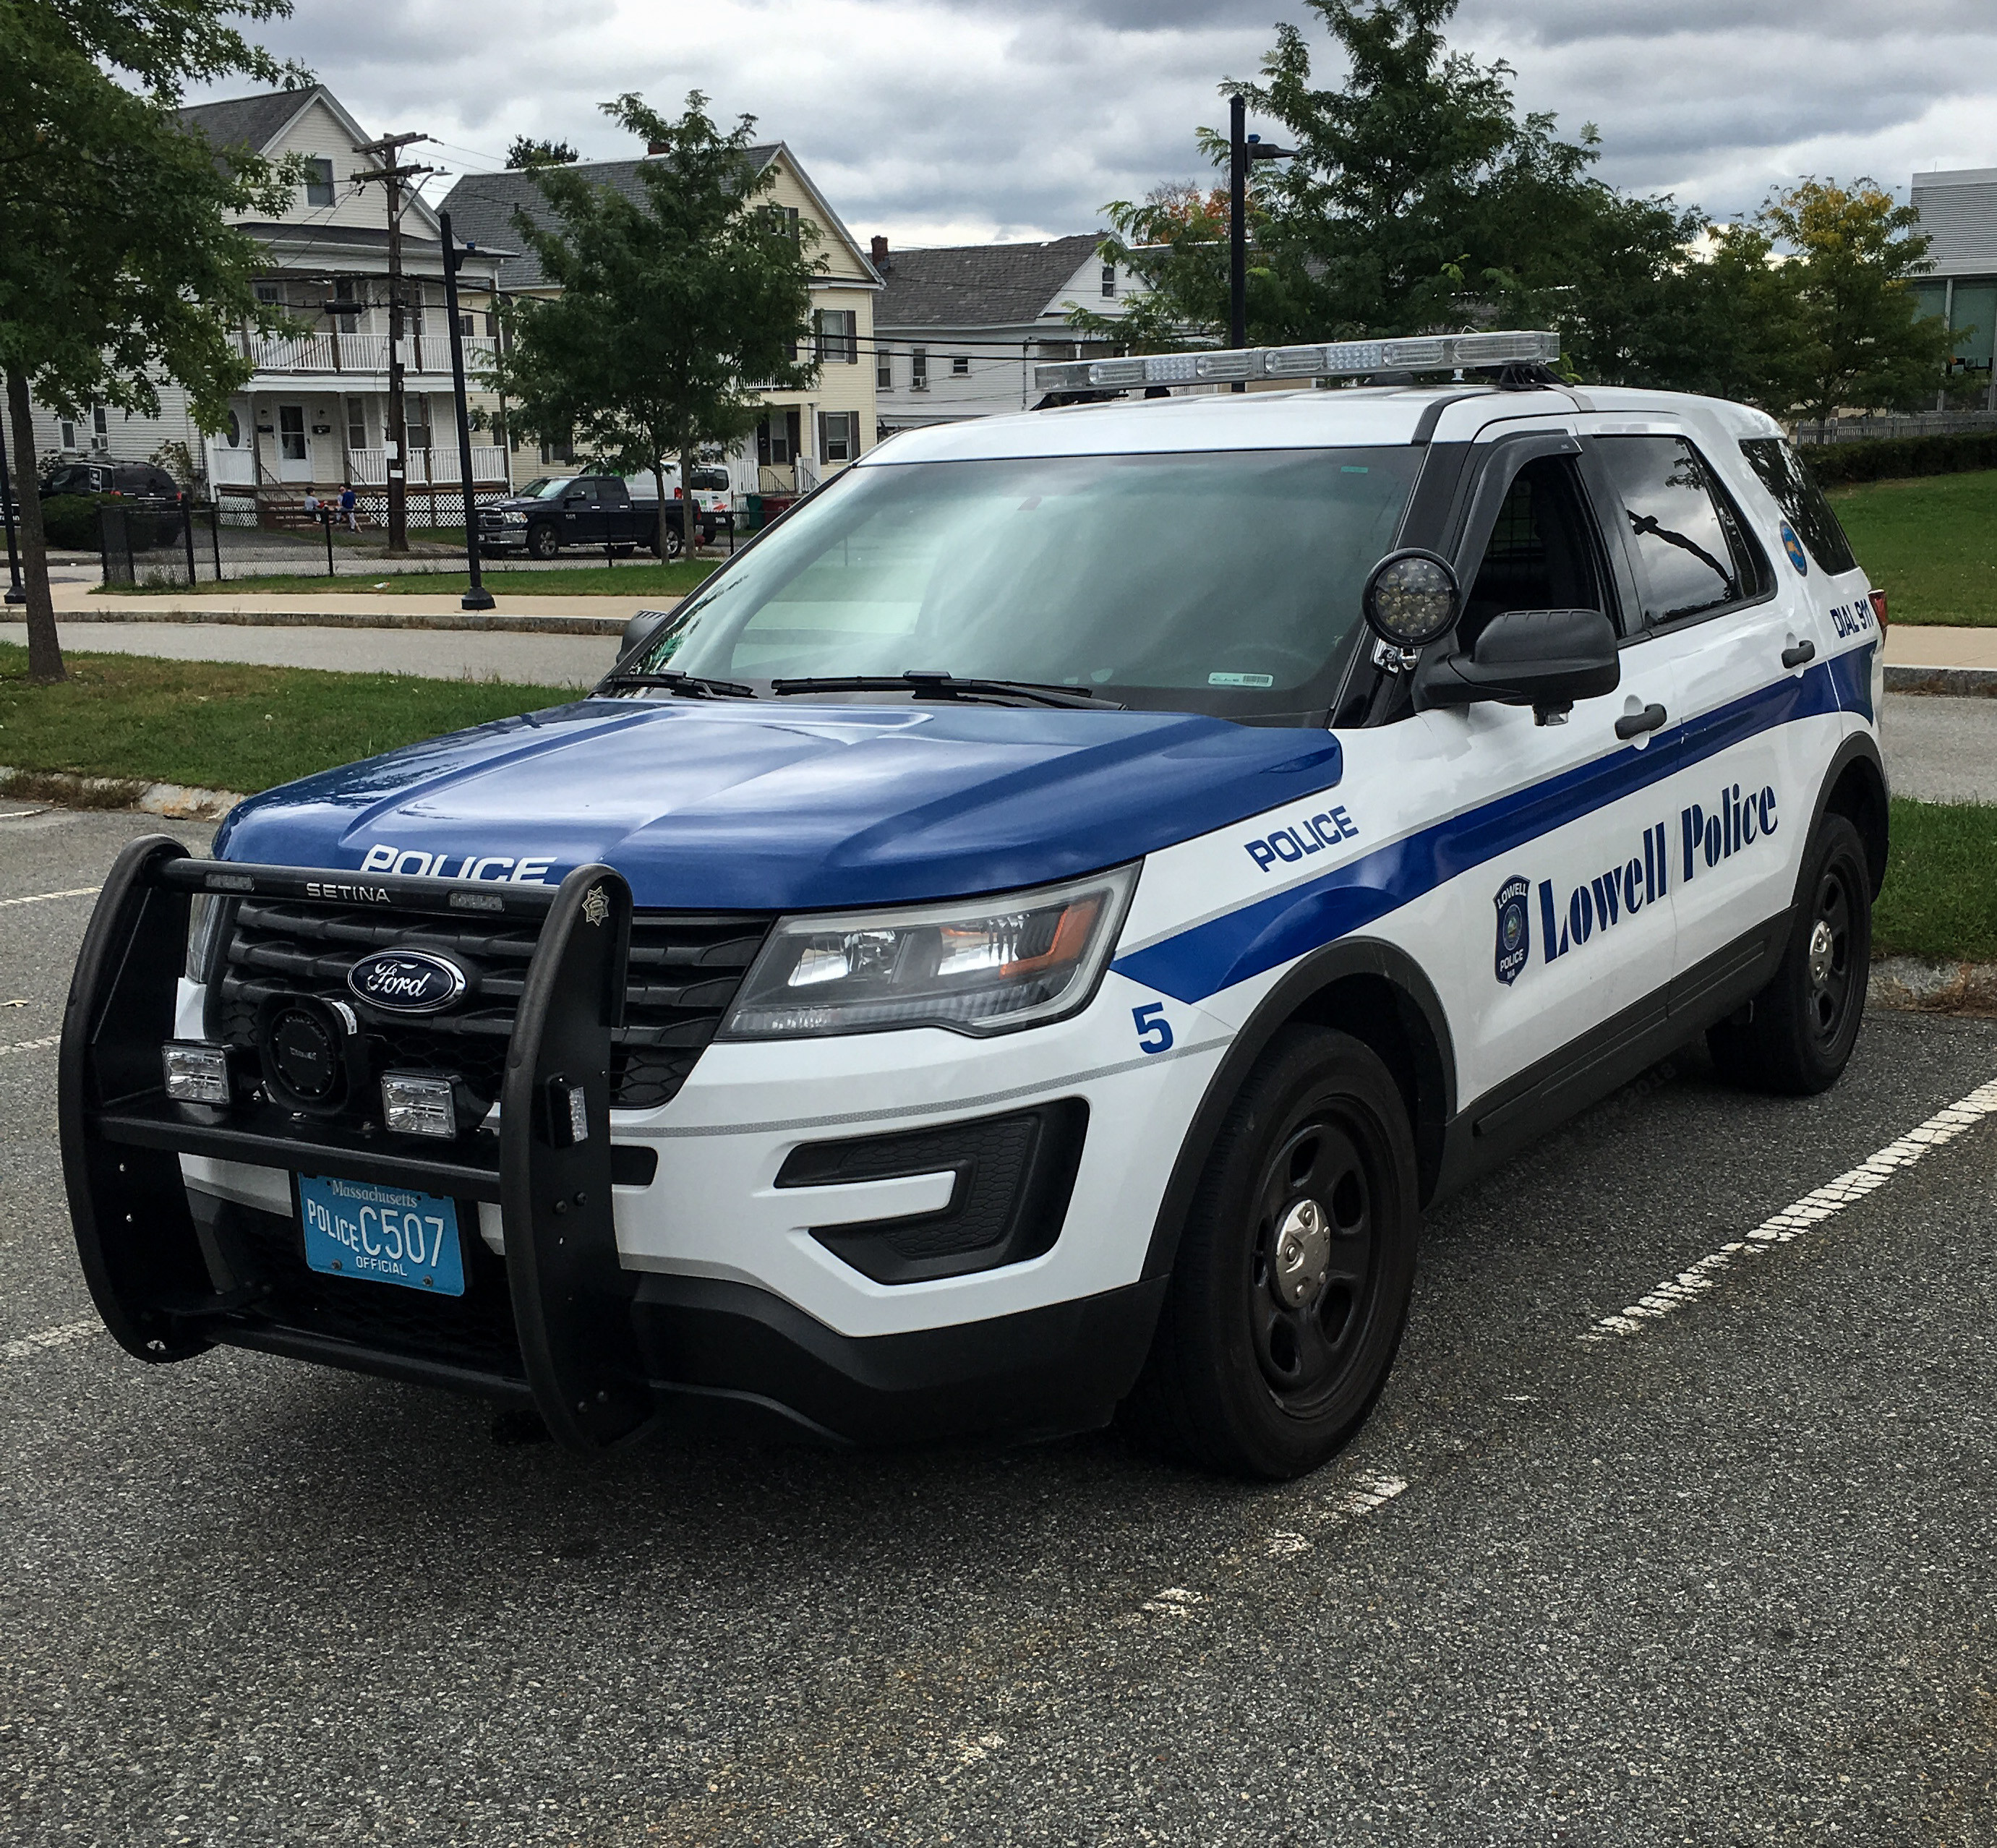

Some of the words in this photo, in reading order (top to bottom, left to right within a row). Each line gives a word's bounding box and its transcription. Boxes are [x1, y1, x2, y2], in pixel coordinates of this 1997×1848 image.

[1829, 604, 1860, 638] DIAL
[1854, 599, 1874, 630] 911
[1244, 805, 1359, 873] POLICE
[359, 844, 558, 884] POLICE
[1538, 821, 1667, 964] Lowell
[1681, 783, 1779, 883] Police
[307, 882, 390, 903] SETINA
[1497, 882, 1527, 910] LOWELL
[366, 959, 432, 998] Ford
[1500, 948, 1524, 972] POLICE
[1132, 1001, 1173, 1054] 5
[331, 1179, 418, 1209] Massachusetts
[307, 1197, 360, 1253] POLICE
[359, 1205, 444, 1268] C507
[356, 1255, 408, 1277] OFFICIAL
